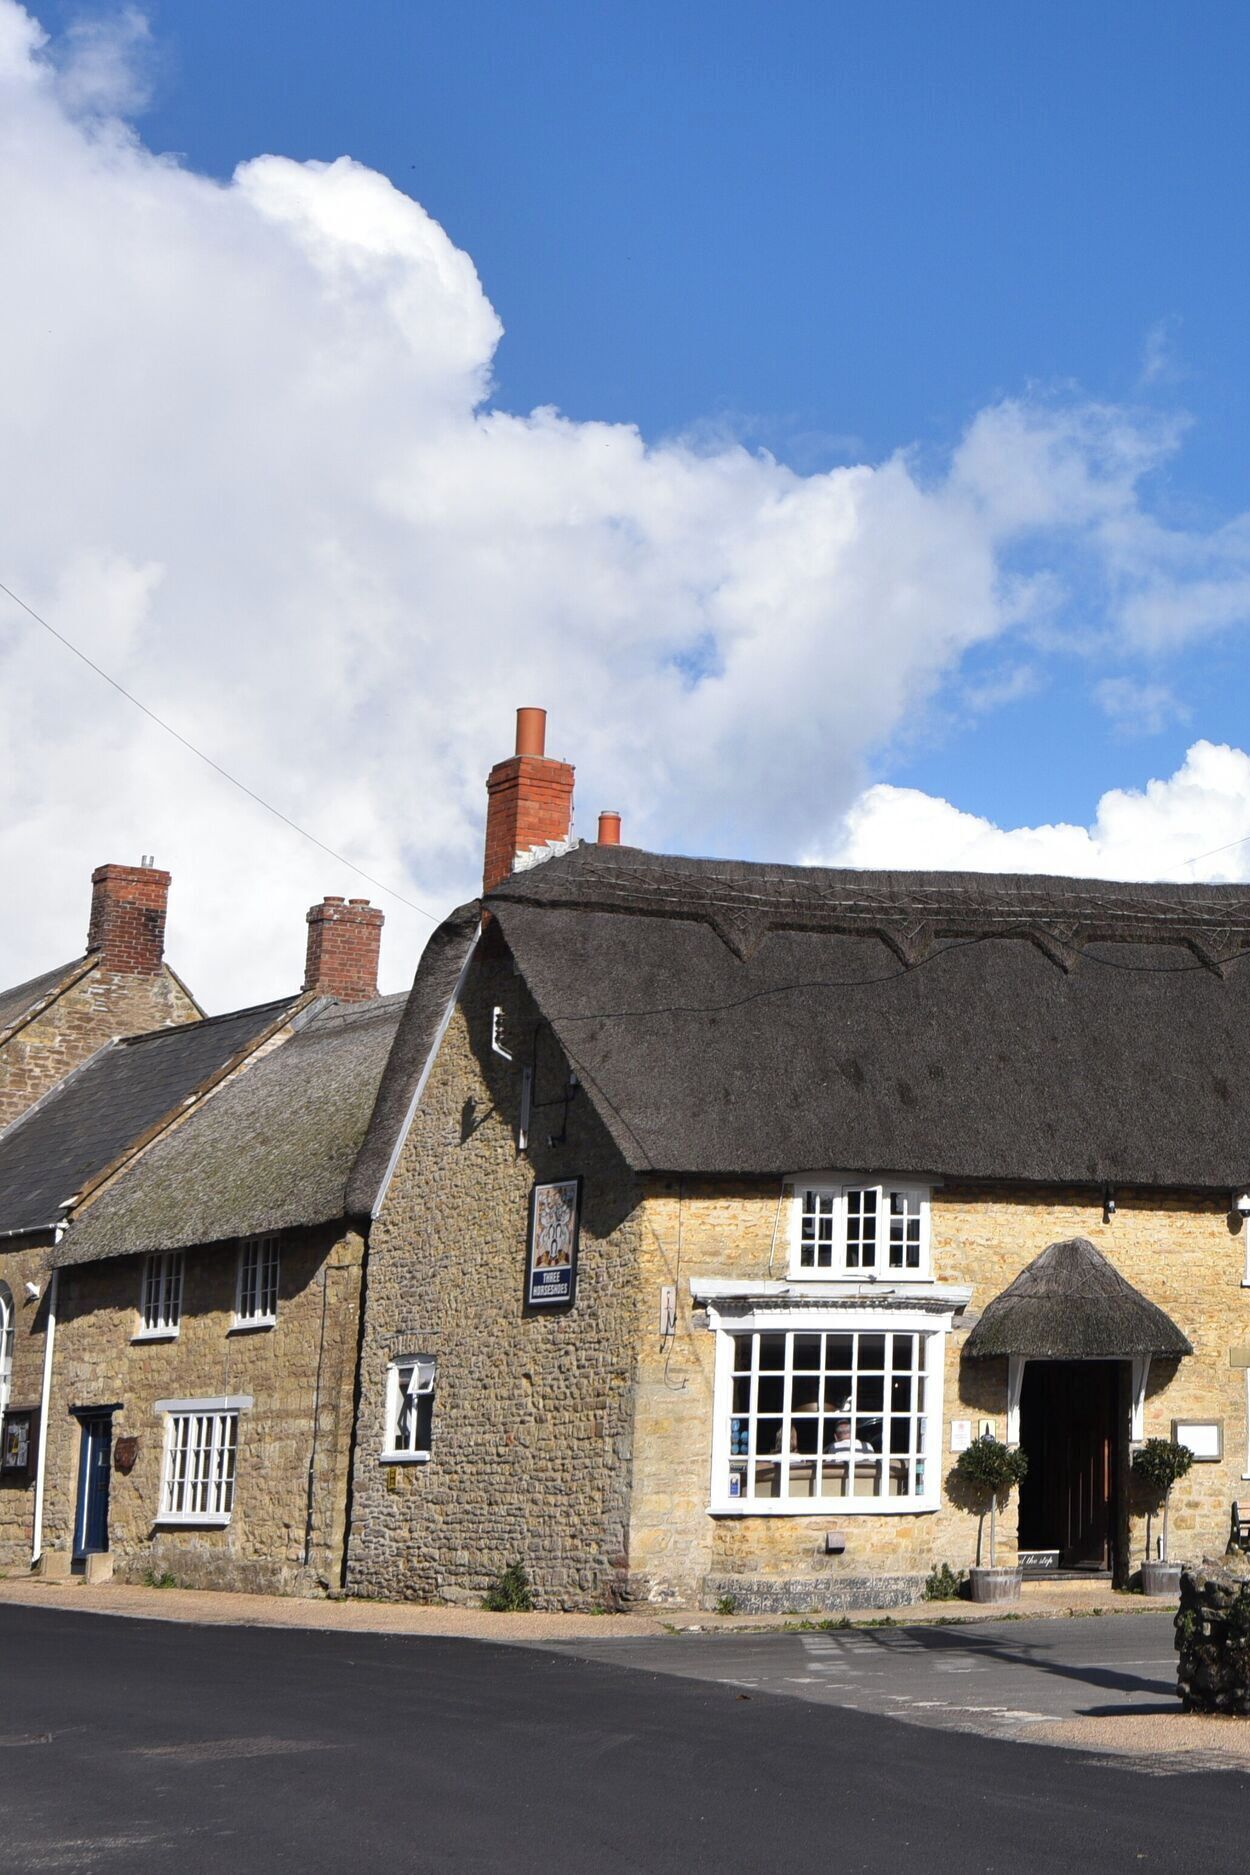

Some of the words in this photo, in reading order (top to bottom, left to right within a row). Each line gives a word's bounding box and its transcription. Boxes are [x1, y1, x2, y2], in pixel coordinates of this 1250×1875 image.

[543, 1271, 560, 1284] THREE
[532, 1282, 568, 1297] HORSESHOES
[1026, 1555, 1038, 1564] the
[1039, 1556, 1053, 1567] step
